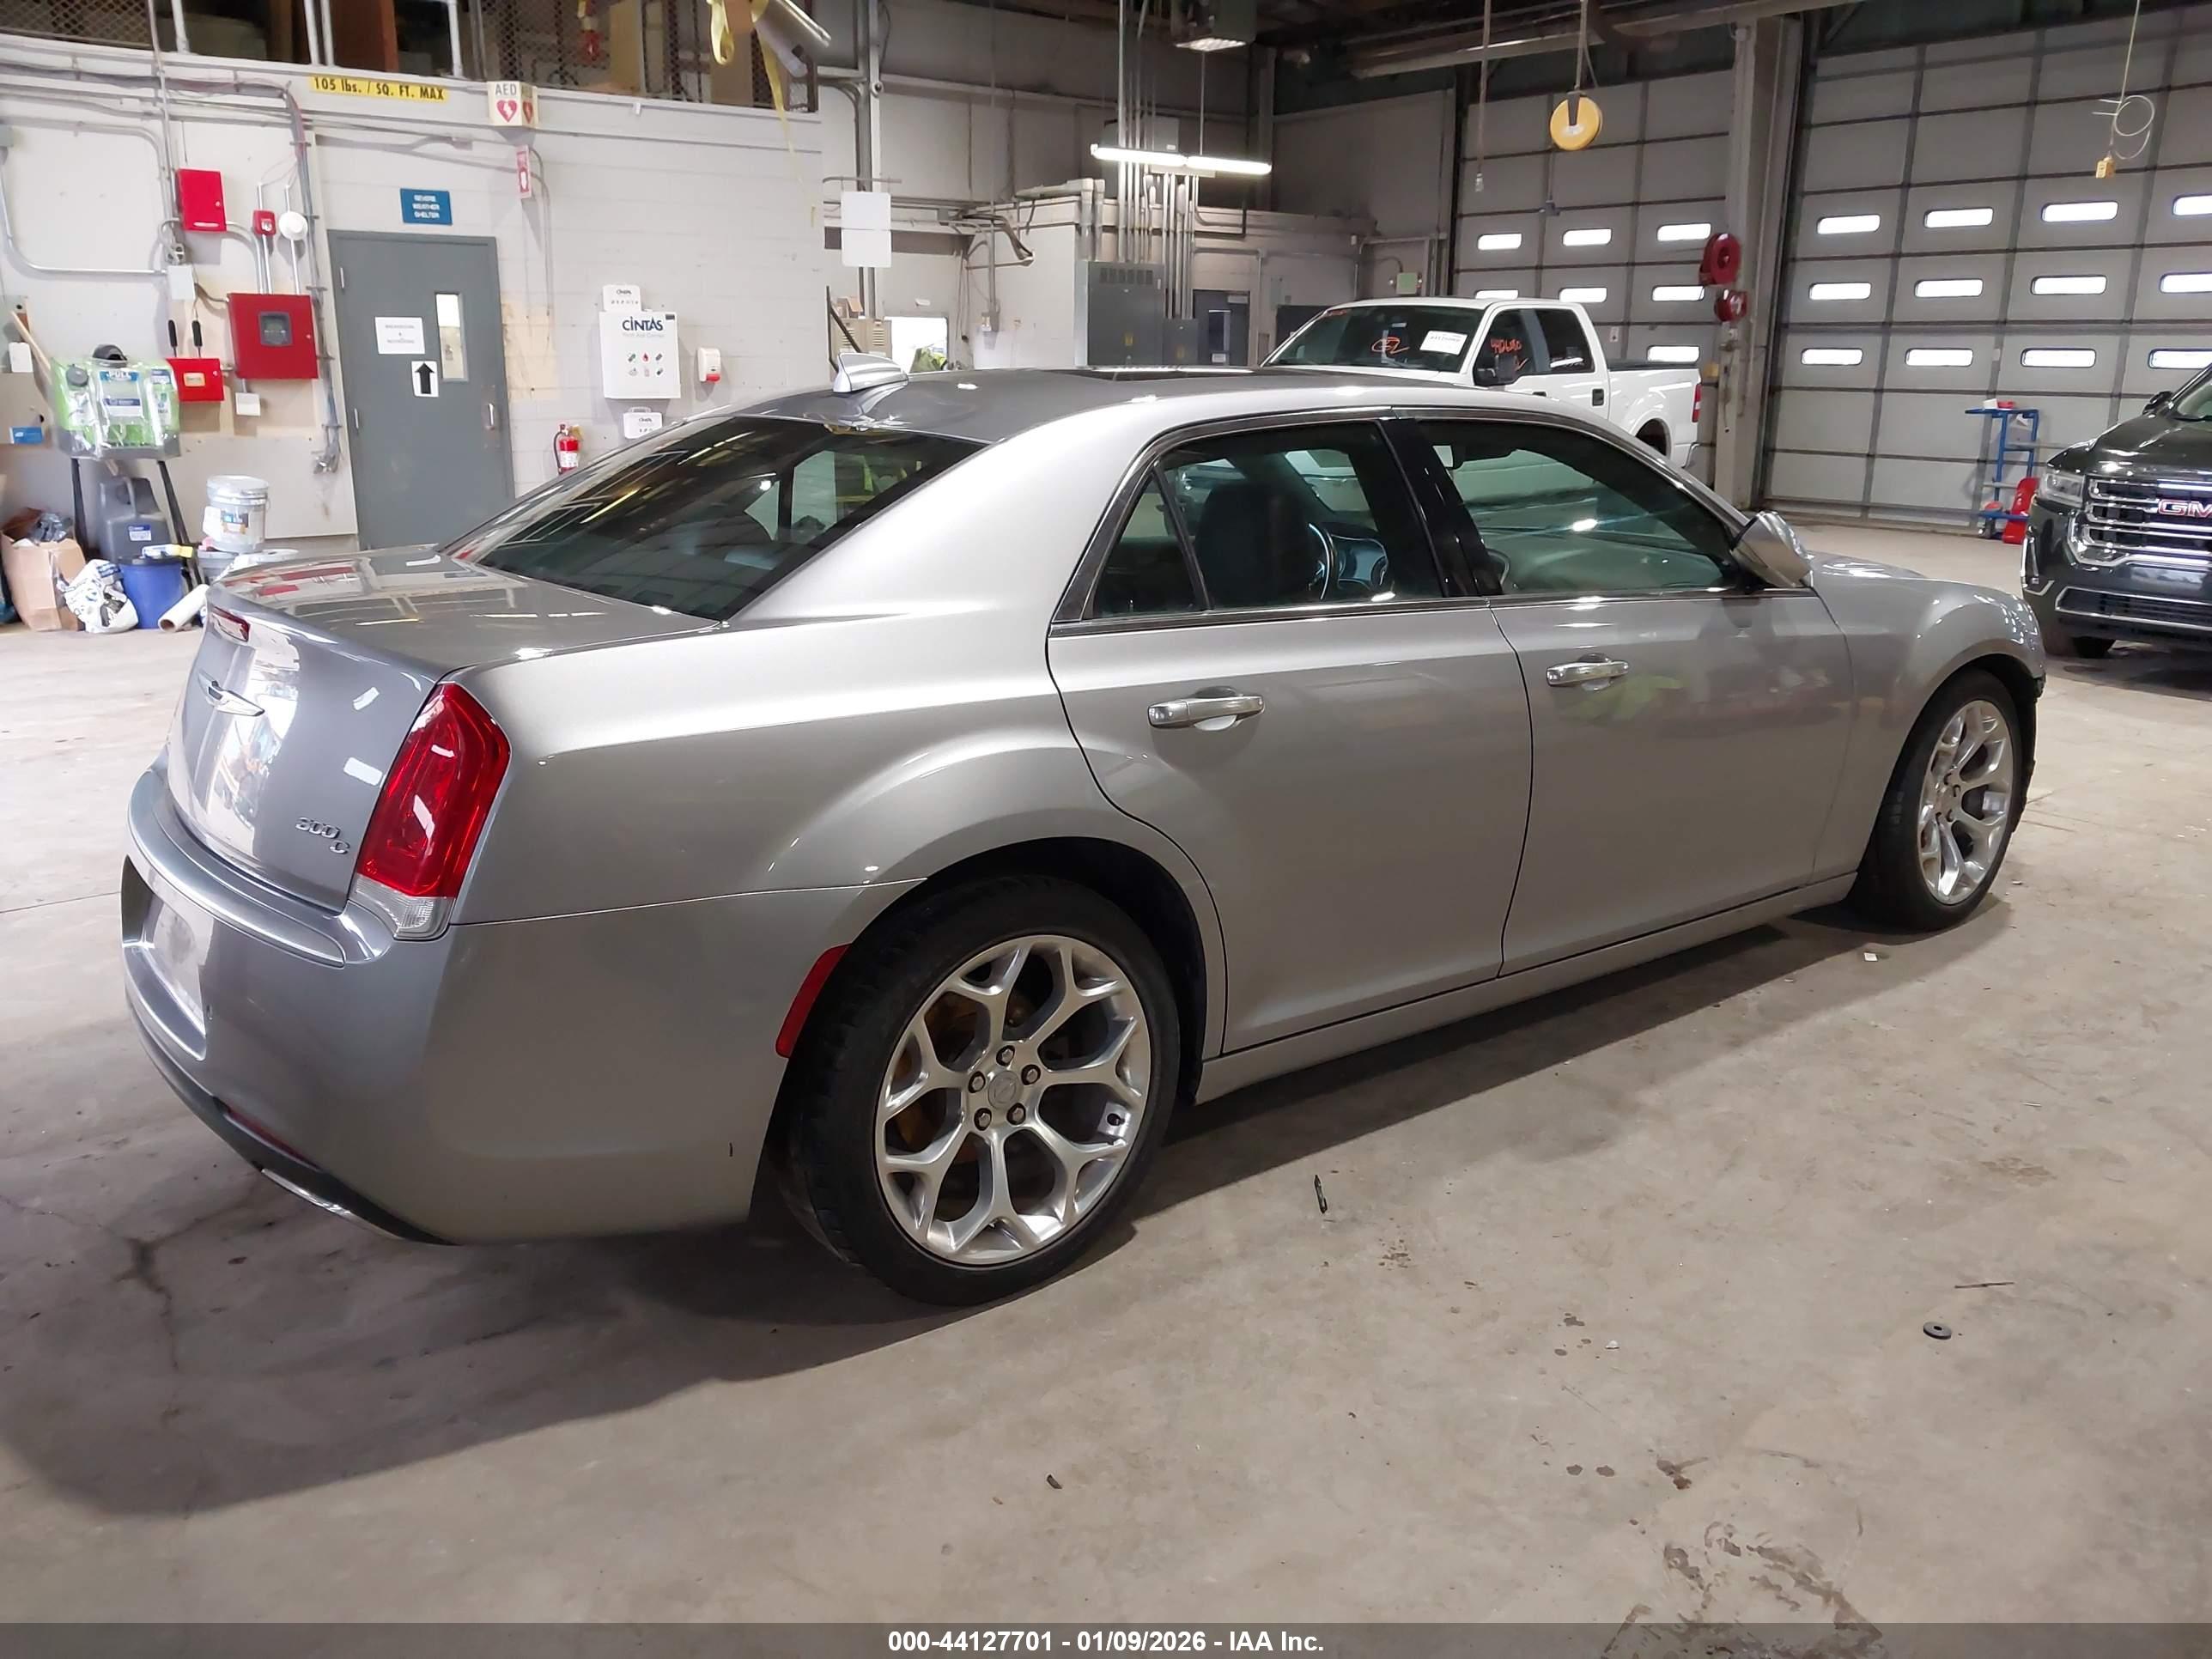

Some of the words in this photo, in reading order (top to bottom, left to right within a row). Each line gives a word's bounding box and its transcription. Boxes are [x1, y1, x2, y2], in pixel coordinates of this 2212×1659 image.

[314, 76, 336, 90] 105
[341, 78, 362, 93] lbs.
[376, 82, 393, 96] SQ.
[399, 84, 414, 97] FT.
[420, 86, 444, 100] MAX
[495, 83, 517, 95] AED
[622, 316, 664, 331] CINTAS
[295, 817, 340, 839] 300
[329, 840, 350, 854] C
